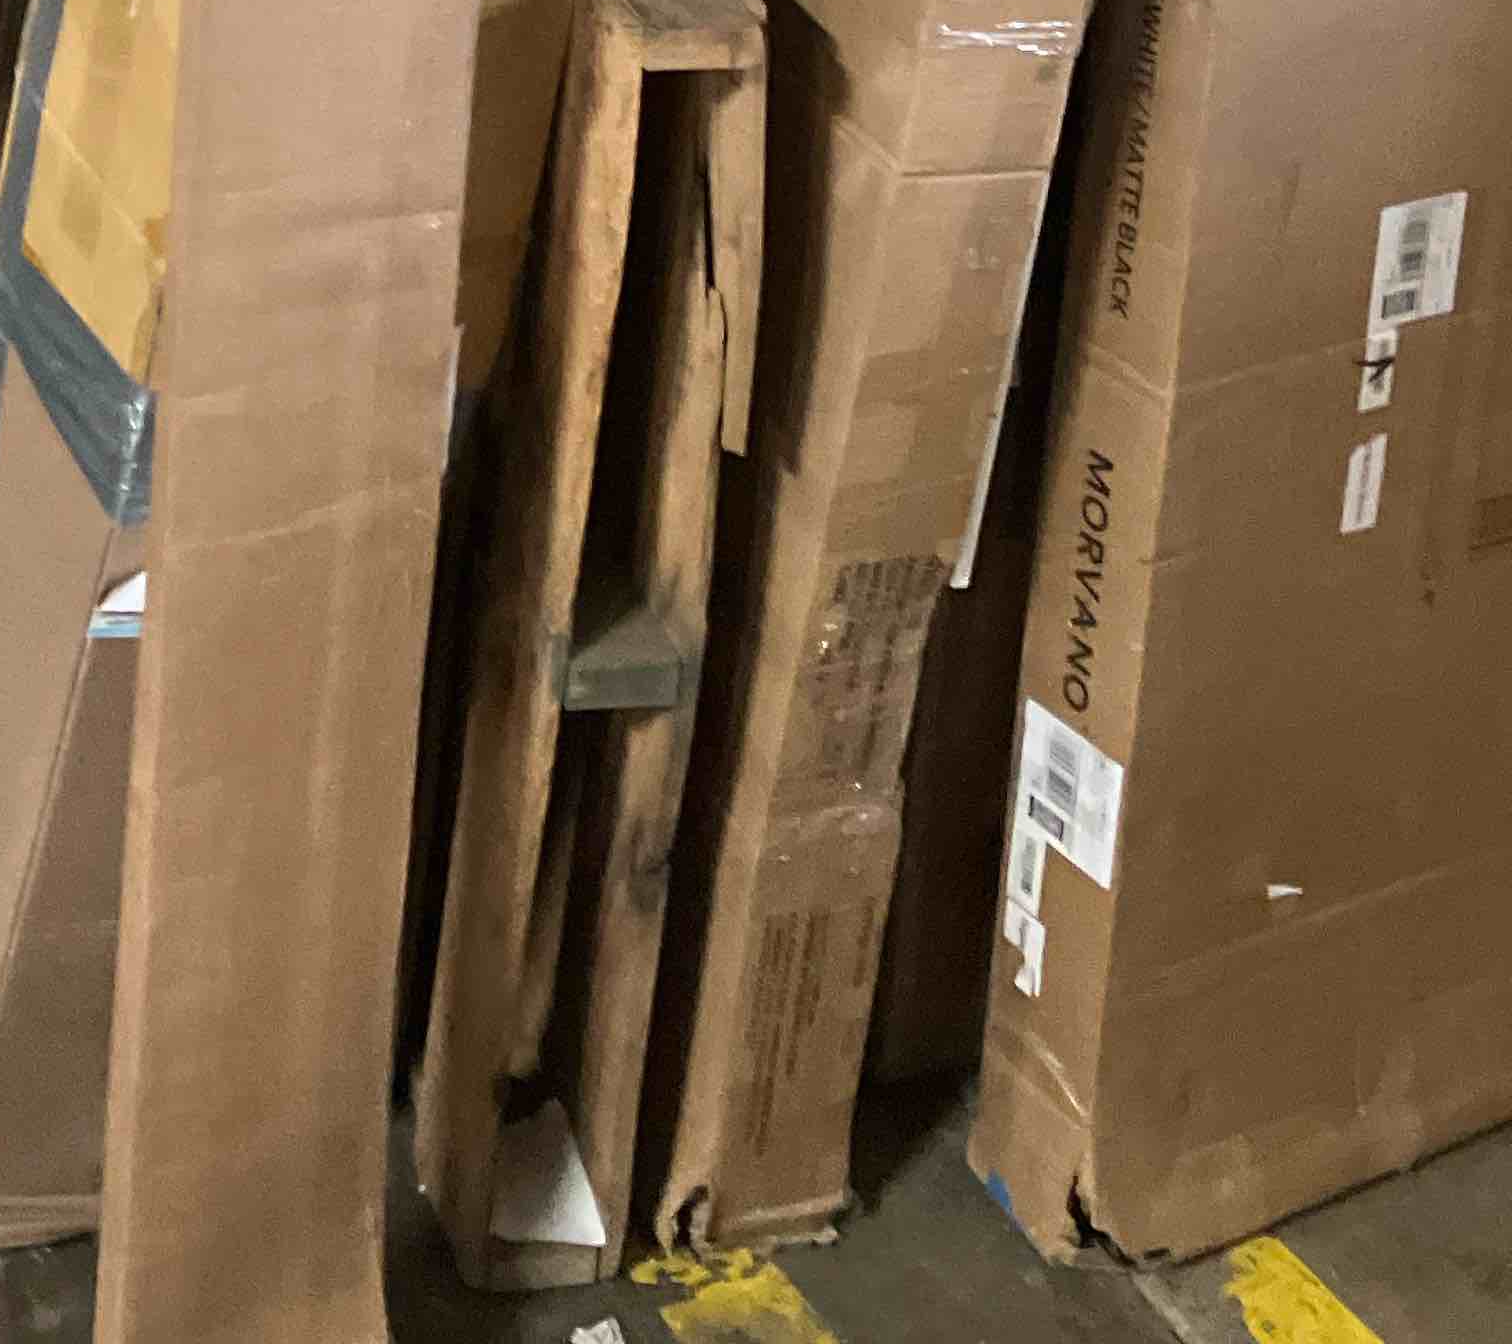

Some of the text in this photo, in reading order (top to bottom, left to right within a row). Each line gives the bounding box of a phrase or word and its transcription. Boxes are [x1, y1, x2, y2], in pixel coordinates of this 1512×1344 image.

[1117, 114, 1150, 221] MATTE
[1109, 223, 1140, 320] BLACK
[1062, 449, 1114, 713] MORVANO
